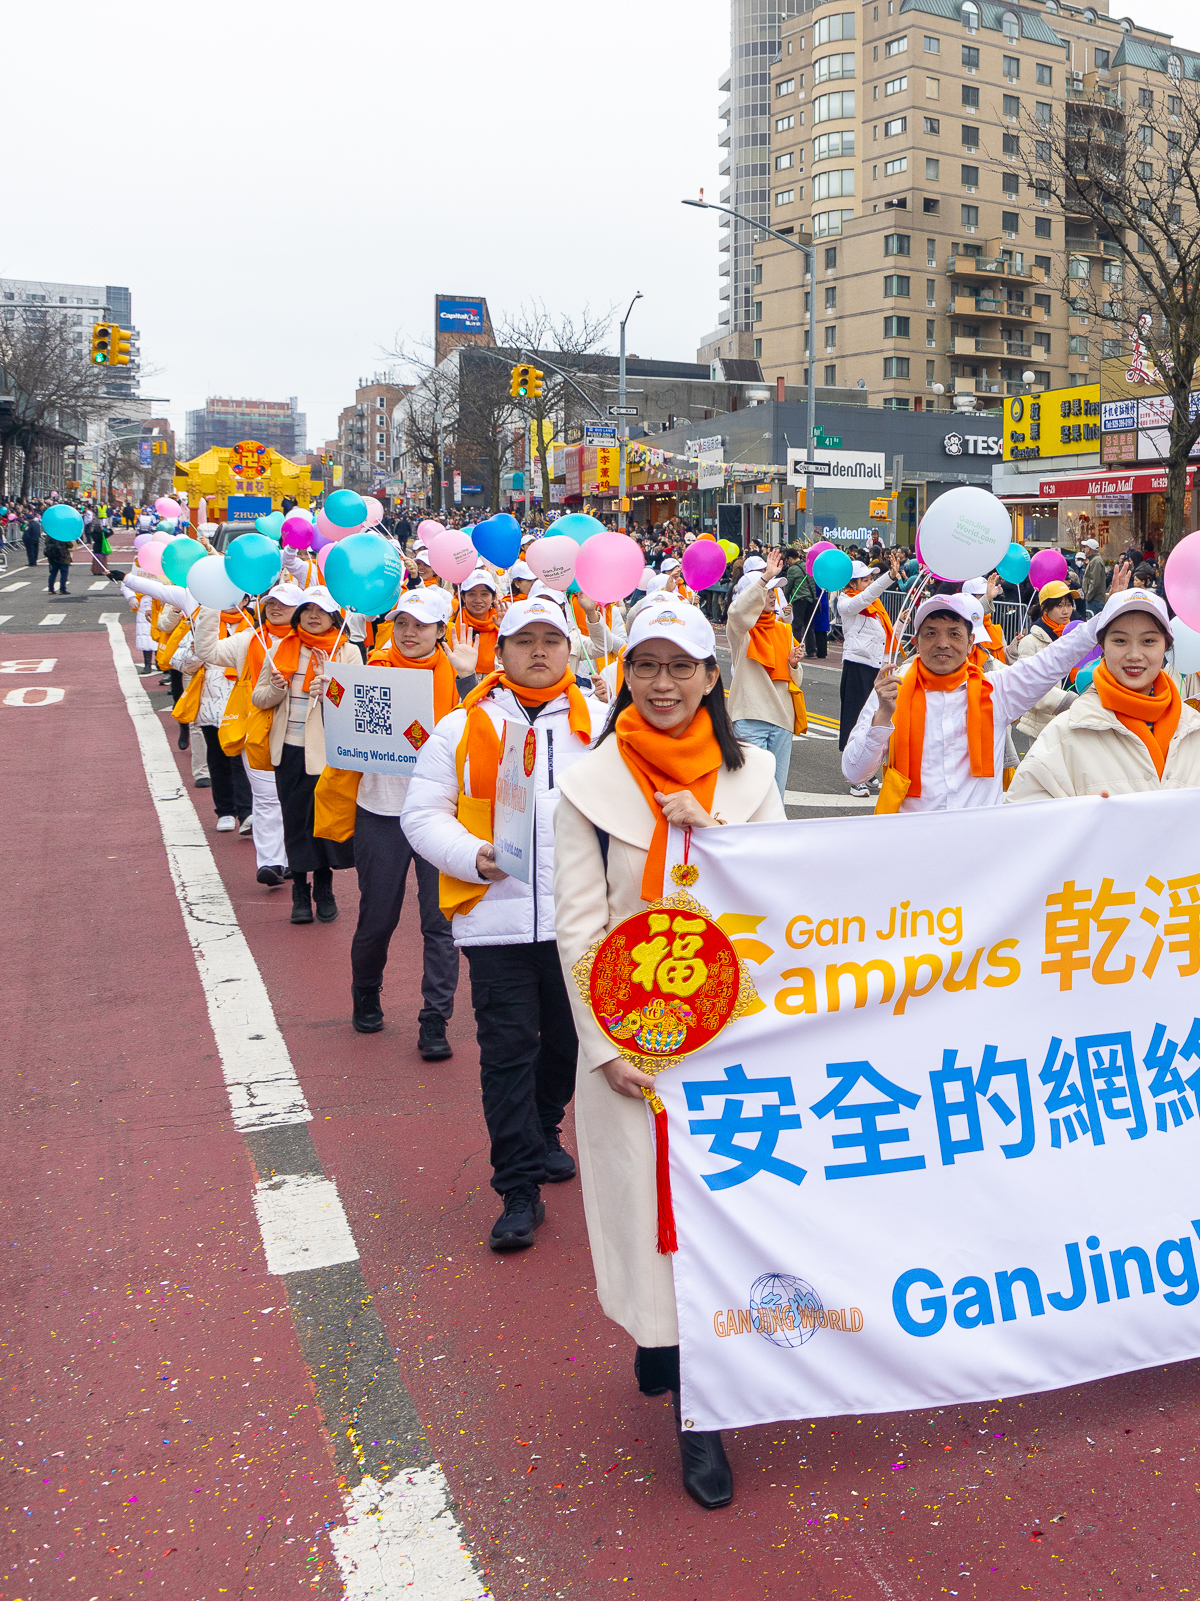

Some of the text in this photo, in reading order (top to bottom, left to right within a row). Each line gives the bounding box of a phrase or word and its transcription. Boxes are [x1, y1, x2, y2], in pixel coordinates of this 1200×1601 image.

[824, 437, 833, 446] 41
[1010, 430, 1025, 443] One
[1010, 445, 1040, 458] Chestnut
[829, 460, 882, 479] ldenMall
[1088, 481, 1101, 494] Mei
[1102, 480, 1116, 493] Hao
[1116, 477, 1135, 492] Mall
[956, 522, 996, 544] World.com
[959, 514, 990, 535] GanJing
[337, 746, 417, 764] GanJing World.com
[785, 900, 963, 950] Gan Jing
[713, 1305, 864, 1337] GAN JING WORLD
